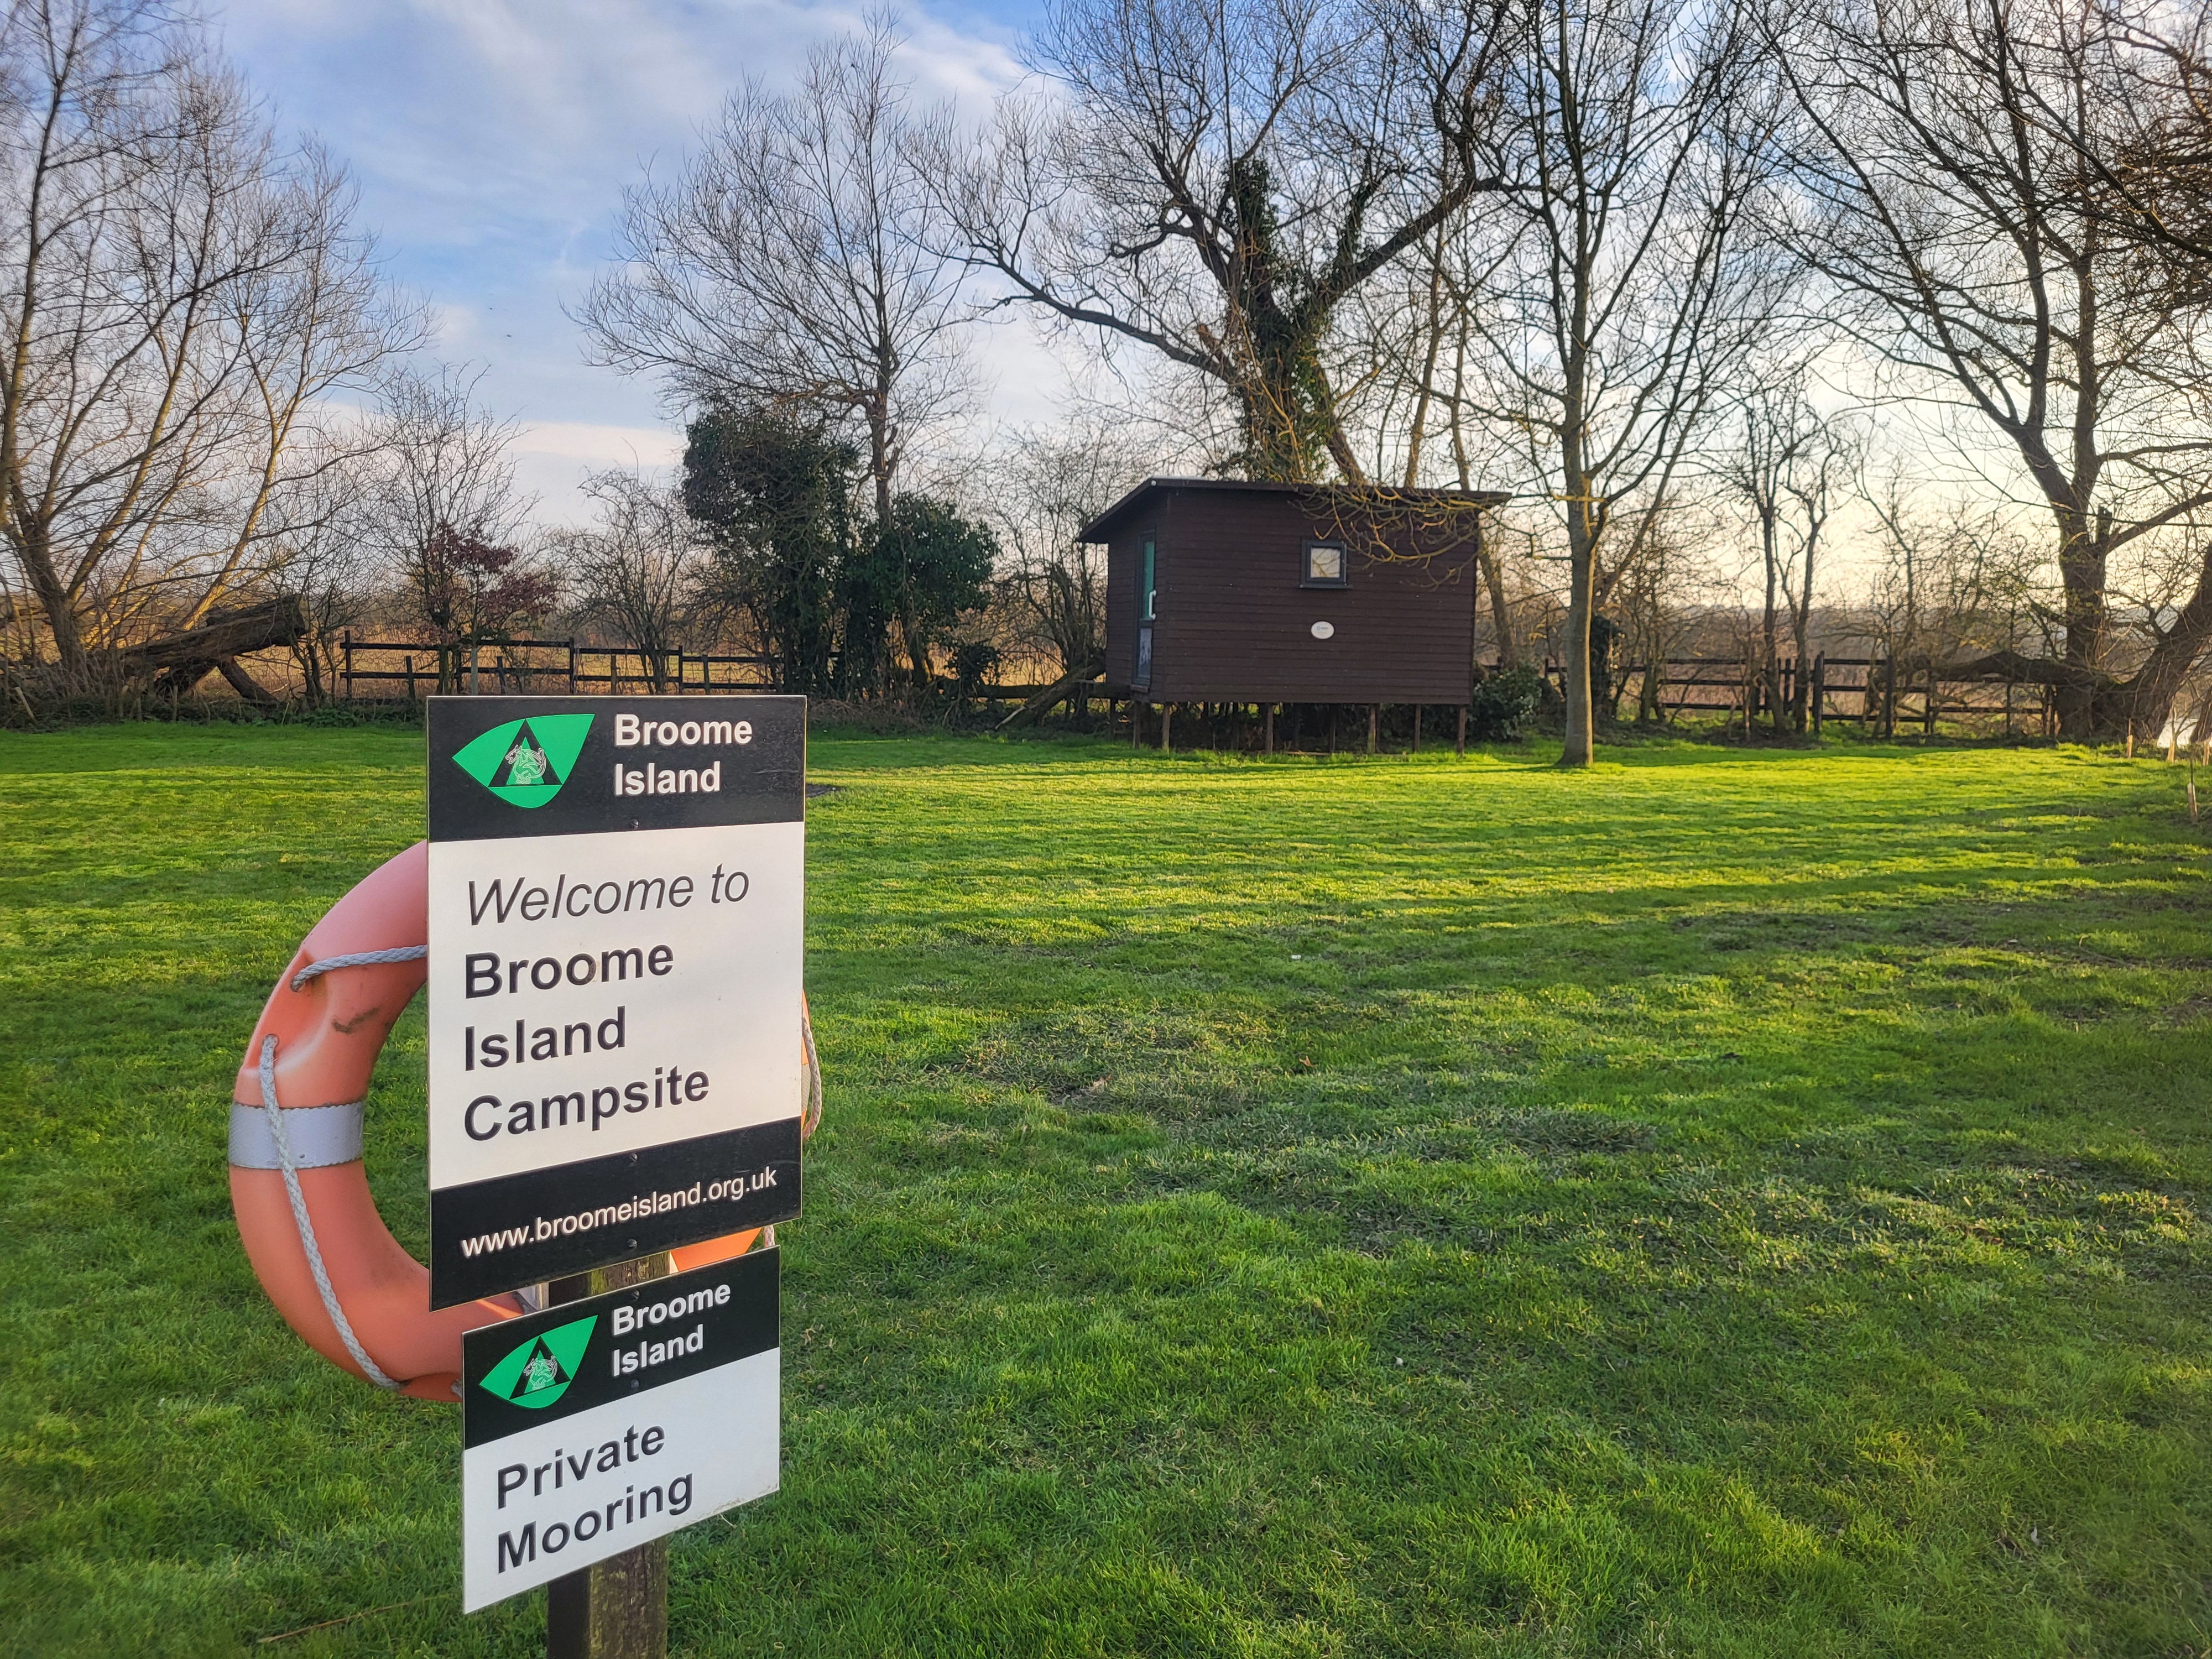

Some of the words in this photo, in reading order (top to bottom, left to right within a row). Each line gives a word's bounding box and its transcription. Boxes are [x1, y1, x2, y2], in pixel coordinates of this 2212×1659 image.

[614, 714, 753, 747] Broome
[614, 760, 721, 796] Island
[468, 874, 693, 926] Welcome
[711, 863, 749, 904] to
[466, 943, 674, 999] Broome
[466, 1005, 625, 1071] Island
[465, 1065, 709, 1141] Campsite
[461, 1166, 778, 1258] www.broomeisland.org.uk
[613, 1284, 731, 1336] Broome
[613, 1323, 703, 1376] Island
[498, 1424, 665, 1510] Private
[498, 1473, 692, 1574] Mooring
